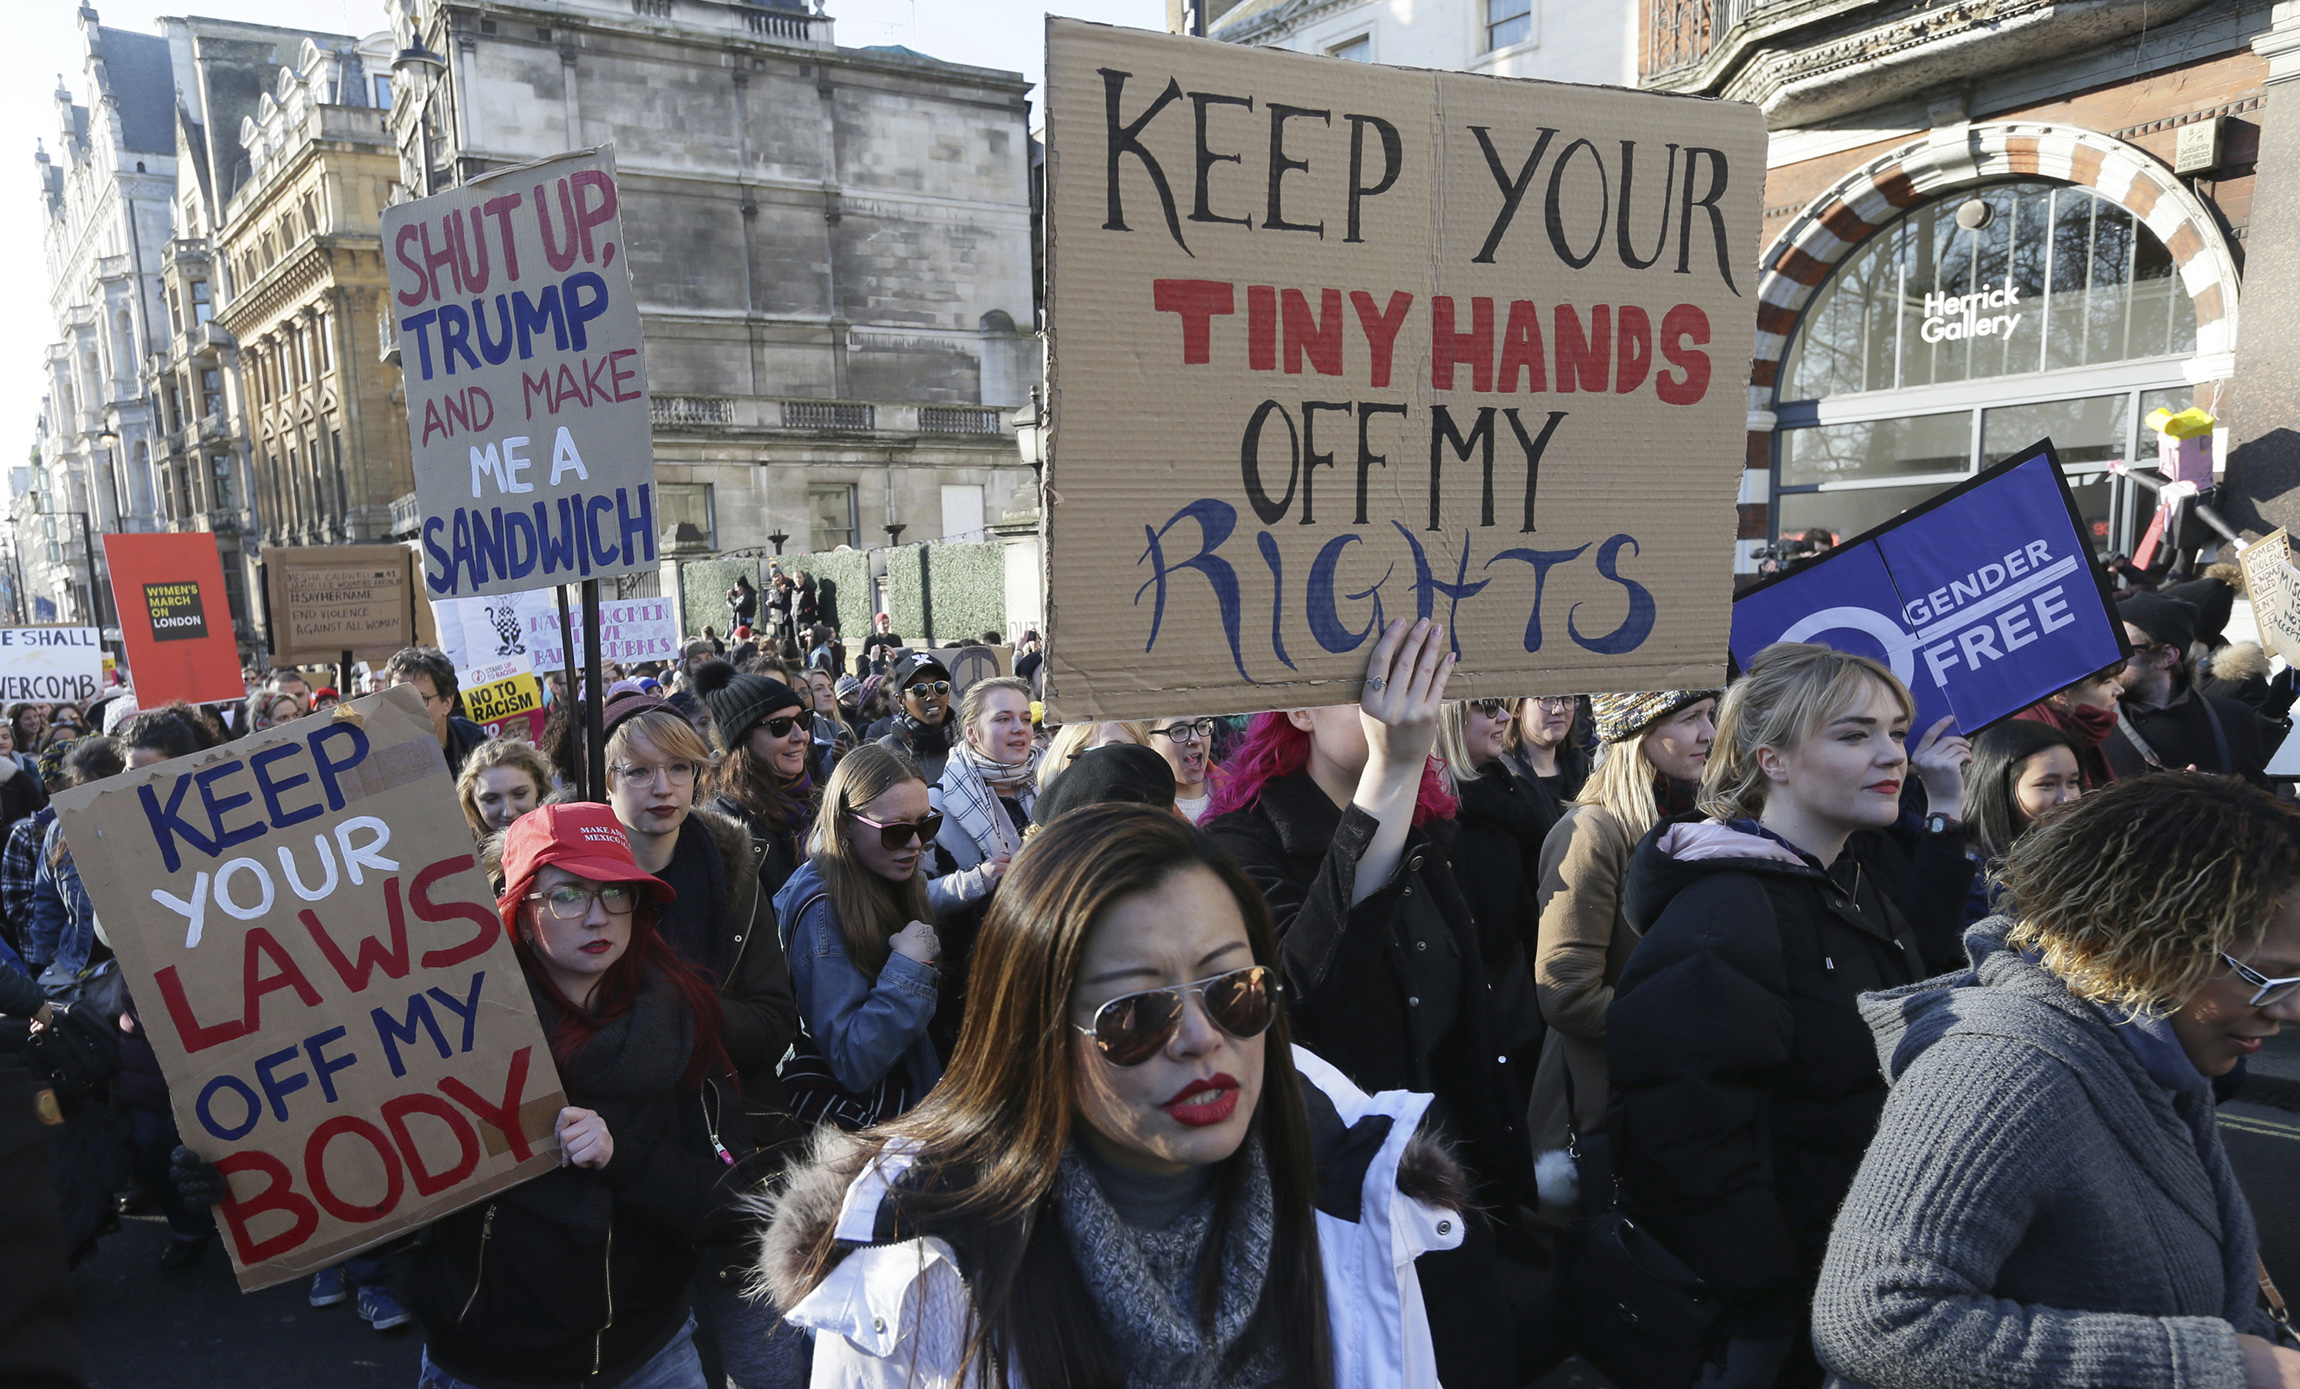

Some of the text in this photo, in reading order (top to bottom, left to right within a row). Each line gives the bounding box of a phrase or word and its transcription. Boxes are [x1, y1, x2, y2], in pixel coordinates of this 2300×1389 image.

[1096, 66, 1742, 297] KEEP YOUR
[397, 169, 618, 307] SHUT UP,
[1924, 276, 2019, 318] Herrick
[401, 271, 609, 381] TRUMP
[1153, 279, 1712, 406] TINY HANDS
[1921, 309, 2021, 343] Gallery
[422, 348, 642, 448] AND MAKE
[469, 425, 588, 498] ME A
[1241, 400, 1568, 533] OFF MY
[423, 483, 655, 596] SANDWICH
[147, 584, 198, 596] WOMEN'S
[149, 596, 190, 607] MARCH
[290, 590, 373, 603] #SAYHERNAME
[1135, 498, 1657, 682] RIGHTS
[1902, 539, 2054, 626] GENDER
[0, 629, 95, 646] E SHALL
[152, 607, 169, 617] ON
[154, 615, 201, 628] LONDON
[292, 607, 369, 620] END VIOLENCE
[296, 617, 400, 635] AGAINST ALL WOMEN
[1923, 585, 2076, 688] FREE
[468, 681, 516, 707] NO TO
[485, 663, 503, 674] STAND
[487, 667, 517, 680] TO RACISM
[473, 692, 533, 722] RACISM
[137, 721, 369, 873] KEEP
[580, 826, 609, 834] MAKE
[584, 834, 621, 843] MEXICO
[151, 816, 400, 949] YOUR
[154, 854, 500, 1053] LAWS
[195, 971, 485, 1141] OFF MY
[213, 1045, 532, 1266] BODY
